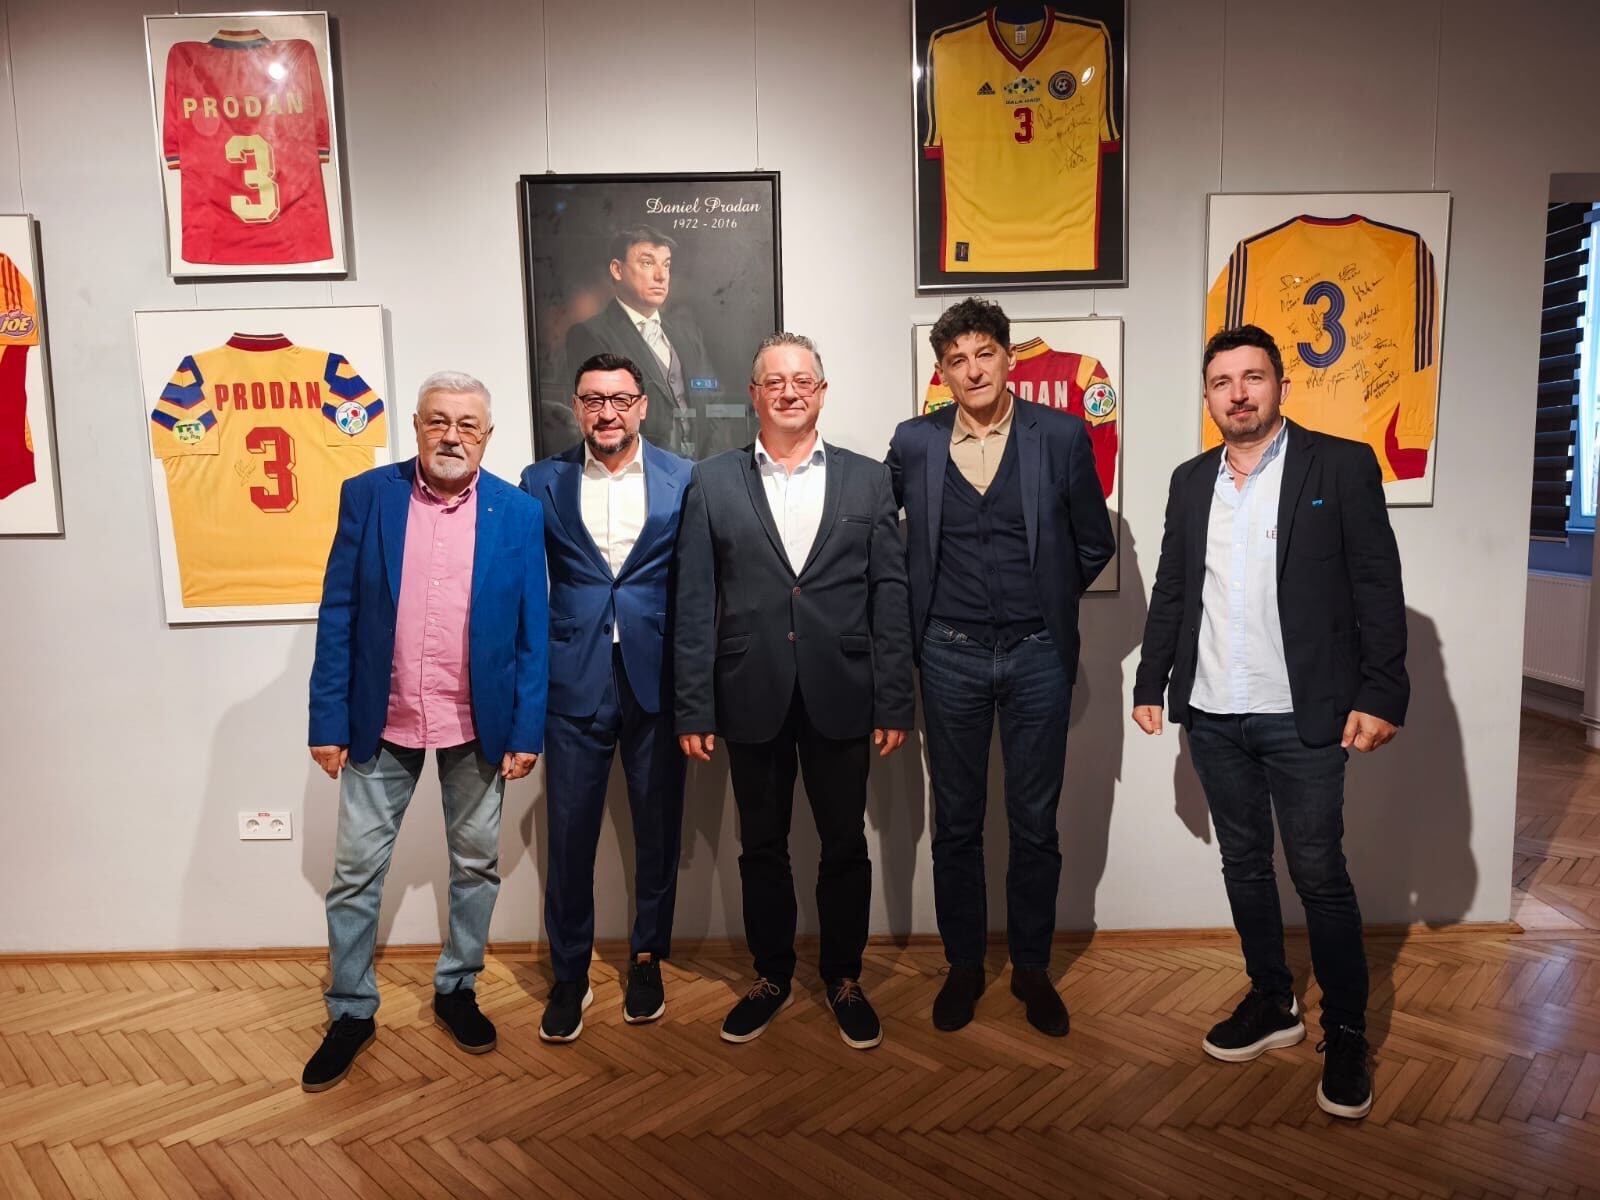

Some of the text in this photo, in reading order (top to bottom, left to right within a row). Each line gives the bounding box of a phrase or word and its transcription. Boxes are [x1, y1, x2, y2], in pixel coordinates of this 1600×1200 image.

[183, 92, 304, 119] PRODAN
[1013, 107, 1034, 145] 3
[225, 133, 280, 224] 3
[646, 196, 761, 214] Daniel Prodan
[673, 218, 699, 230] 1972
[711, 218, 737, 229] 2016
[0, 316, 32, 333] JOE
[1297, 281, 1346, 368] 3
[214, 381, 322, 411] PRODAN
[245, 426, 299, 514] 3
